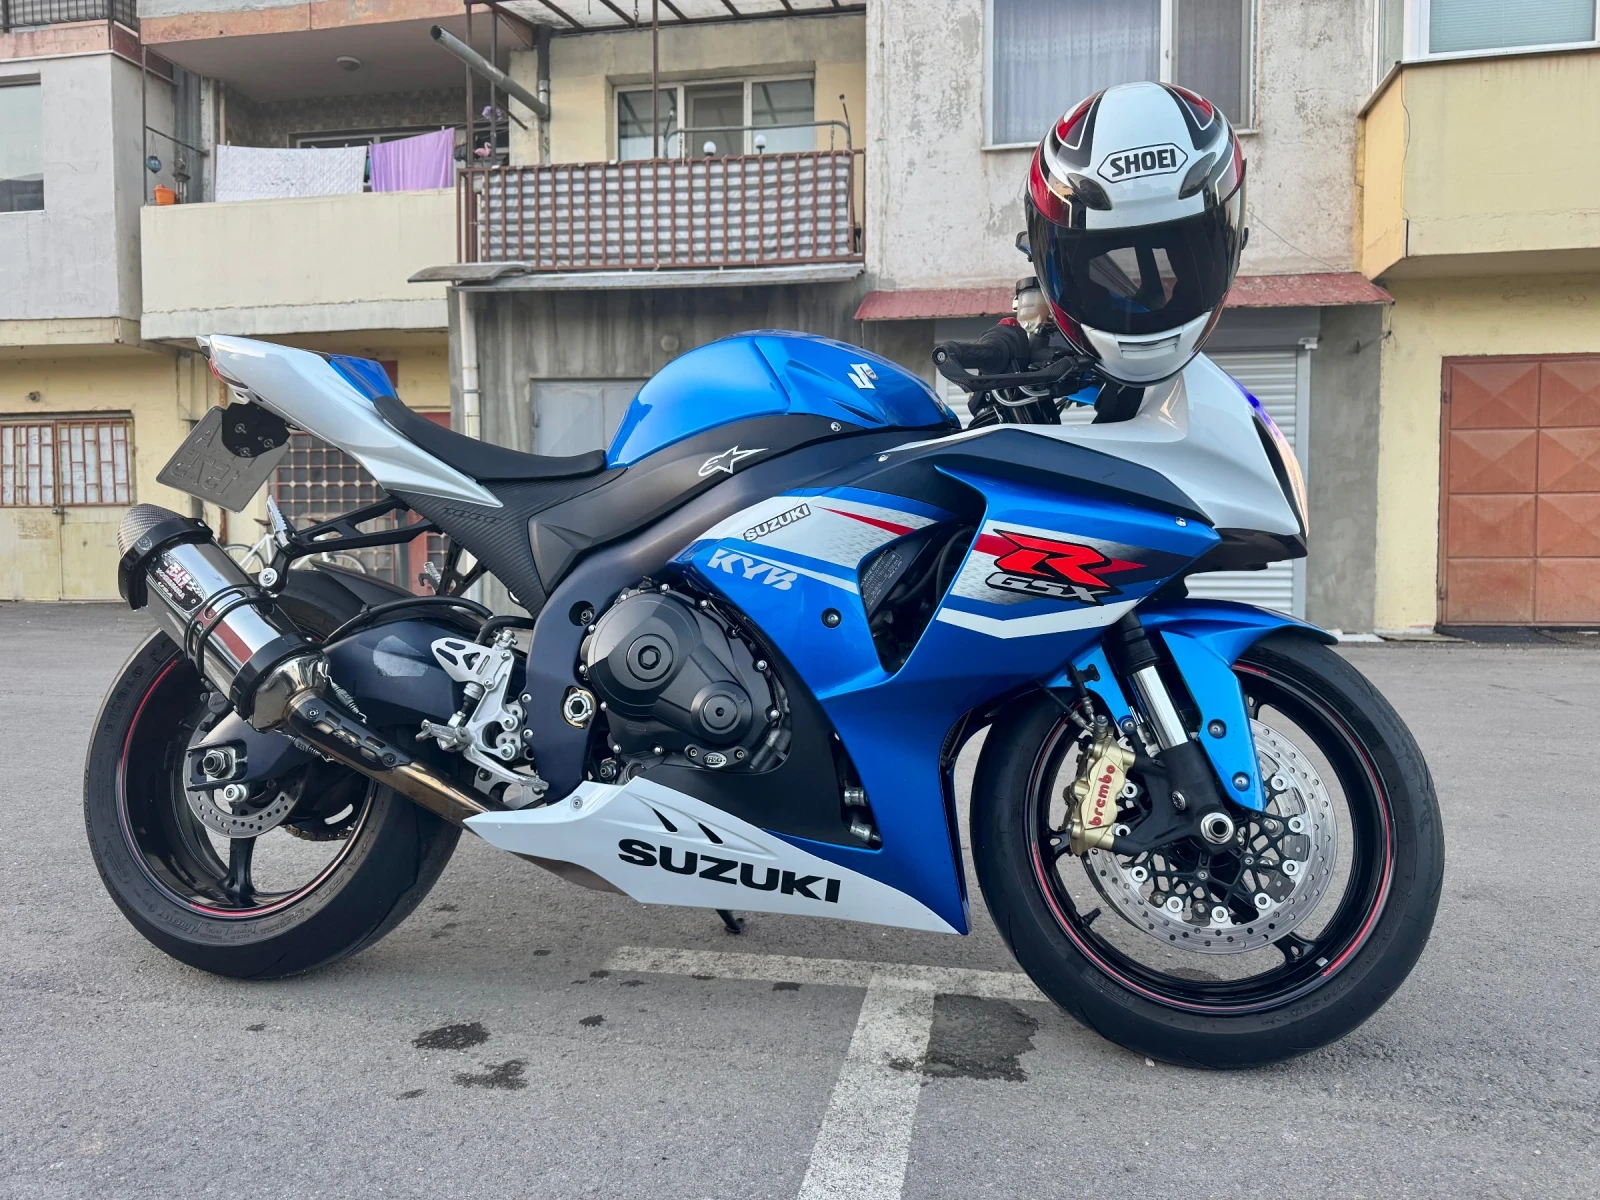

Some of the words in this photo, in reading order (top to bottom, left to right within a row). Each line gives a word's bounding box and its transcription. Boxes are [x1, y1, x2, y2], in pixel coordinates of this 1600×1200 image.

[1109, 148, 1177, 178] SHOEI
[743, 503, 811, 542] SUZUKI
[707, 548, 798, 590] KYB
[993, 528, 1121, 592] R
[985, 572, 1111, 605] GSX
[1088, 764, 1116, 826] brembo
[618, 838, 841, 903] SUZUKI
